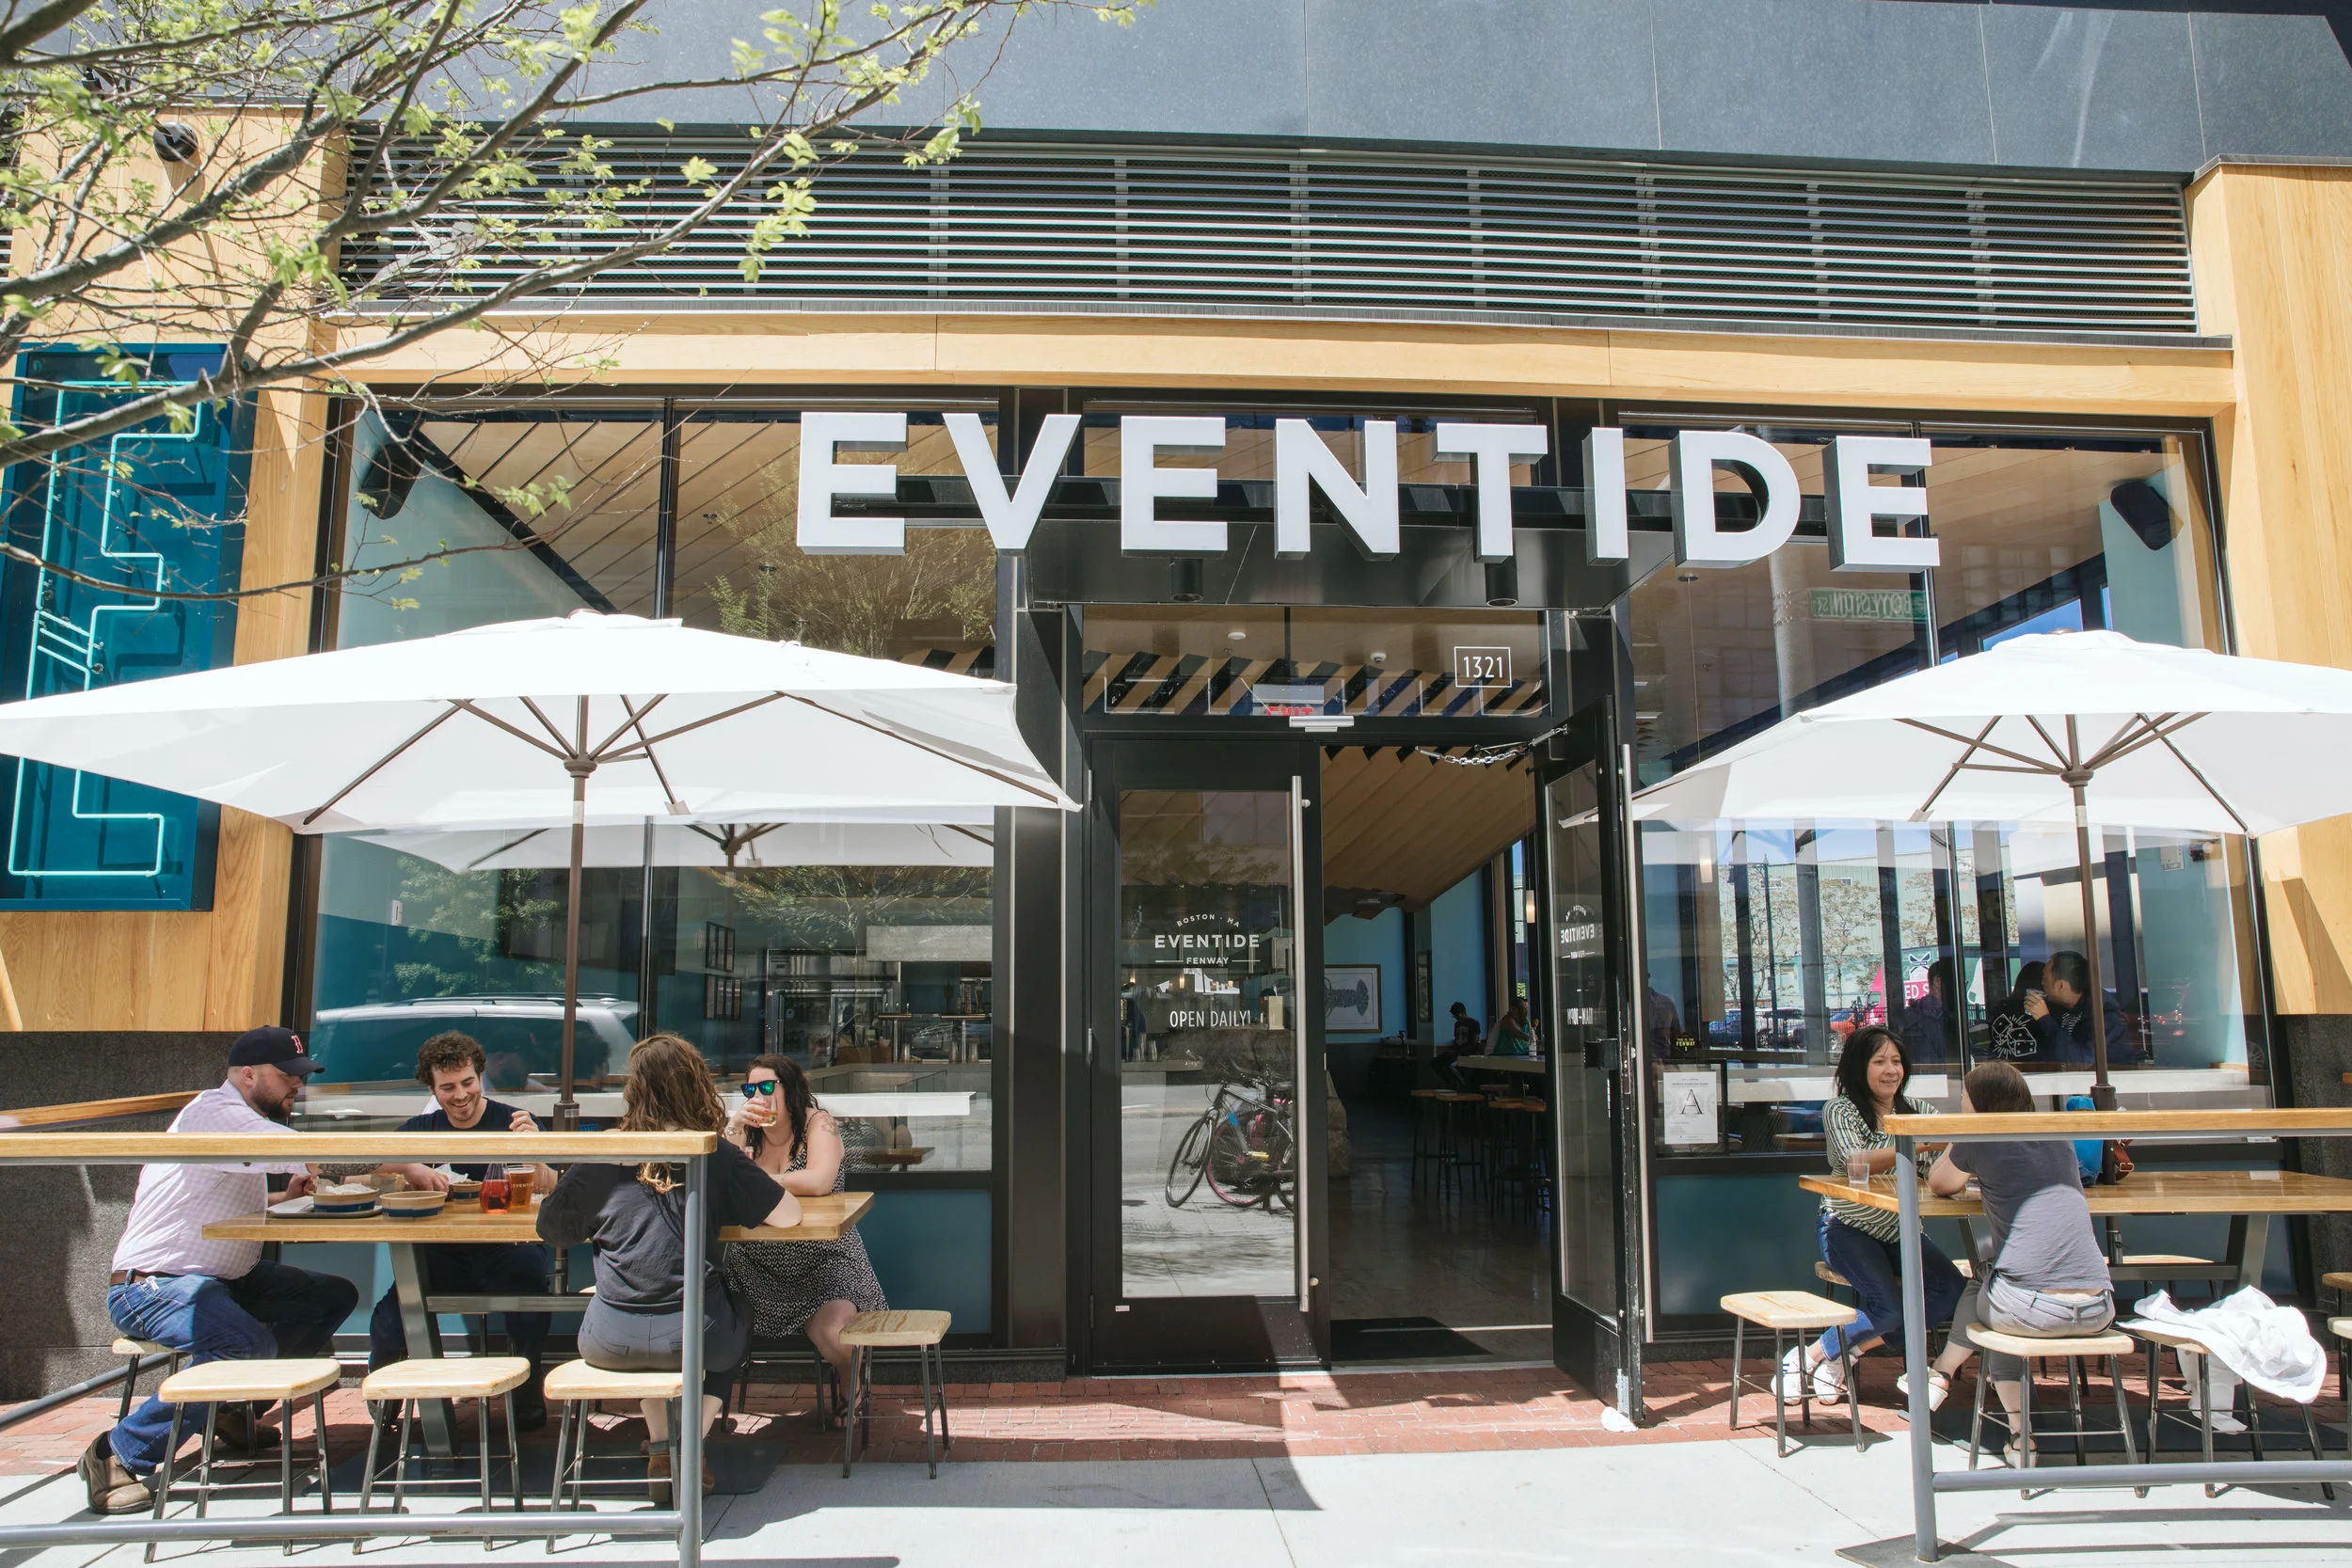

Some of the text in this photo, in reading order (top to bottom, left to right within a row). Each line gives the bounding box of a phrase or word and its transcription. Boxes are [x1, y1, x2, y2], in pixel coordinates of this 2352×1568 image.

[797, 411, 1940, 570] EVENTIDE
[1463, 656, 1503, 678] 1321
[1176, 913, 1240, 927] BOSTON MA
[1154, 934, 1260, 948] EVENTIDE
[1186, 957, 1230, 965] FENWAY
[1169, 1010, 1205, 1027] OPEN
[1679, 1088, 1705, 1115] A
